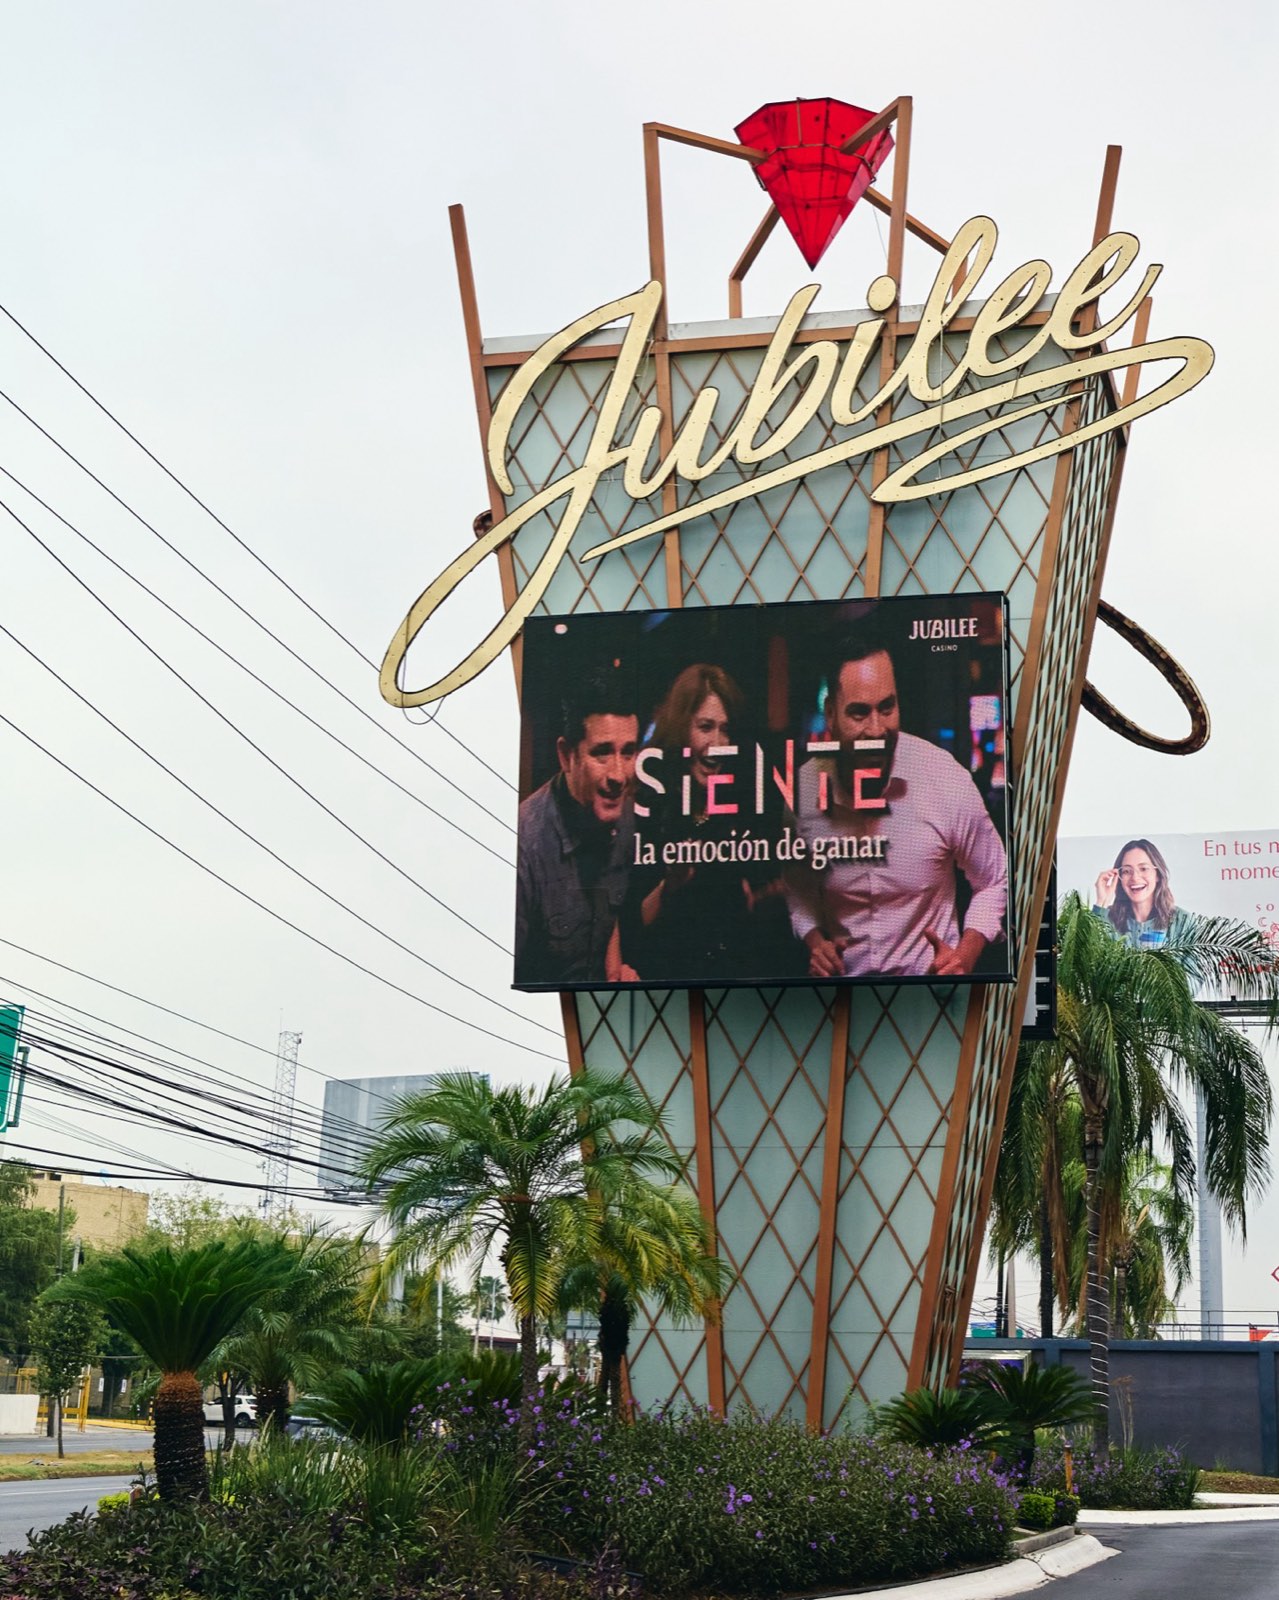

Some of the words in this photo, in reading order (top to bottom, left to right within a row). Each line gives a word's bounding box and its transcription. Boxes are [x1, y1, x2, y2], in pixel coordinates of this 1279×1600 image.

[380, 216, 1163, 707] Jubilee
[908, 617, 979, 639] JUBILEE
[931, 644, 959, 653] CASINO
[633, 832, 656, 865] la
[662, 830, 770, 864] emoción
[776, 827, 806, 861] de
[811, 835, 887, 870] ganar
[1204, 839, 1226, 857] En
[1233, 840, 1262, 856] tus
